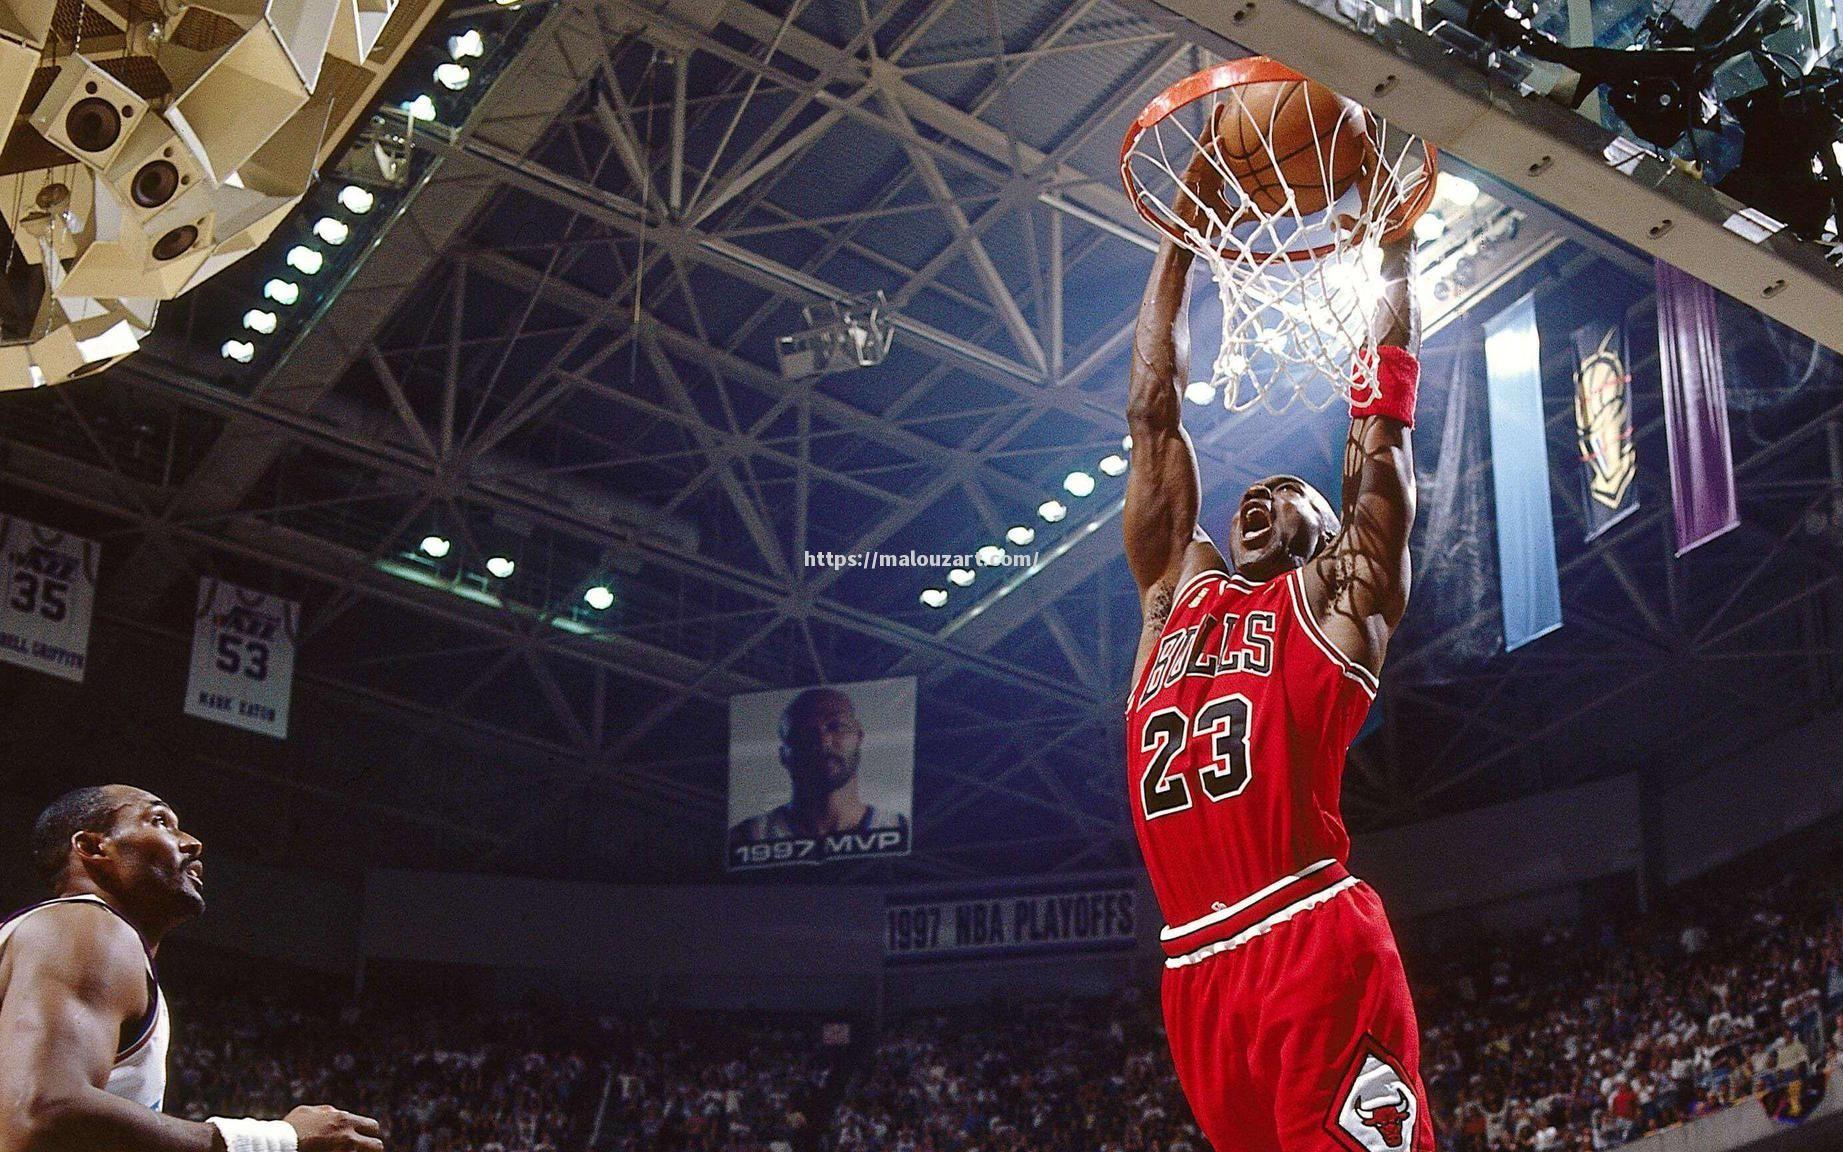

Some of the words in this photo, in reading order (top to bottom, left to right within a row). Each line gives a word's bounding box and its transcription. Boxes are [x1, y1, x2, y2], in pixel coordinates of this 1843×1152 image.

[11, 571, 68, 622] 35
[216, 633, 270, 681] 53
[1136, 611, 1276, 712] BULLS
[1140, 692, 1252, 820] 23
[737, 839, 816, 863] 1997
[825, 832, 900, 852] MVP
[889, 906, 941, 951] 1997
[955, 902, 1004, 946] NBA
[1014, 893, 1135, 942] PLAYOFFS
